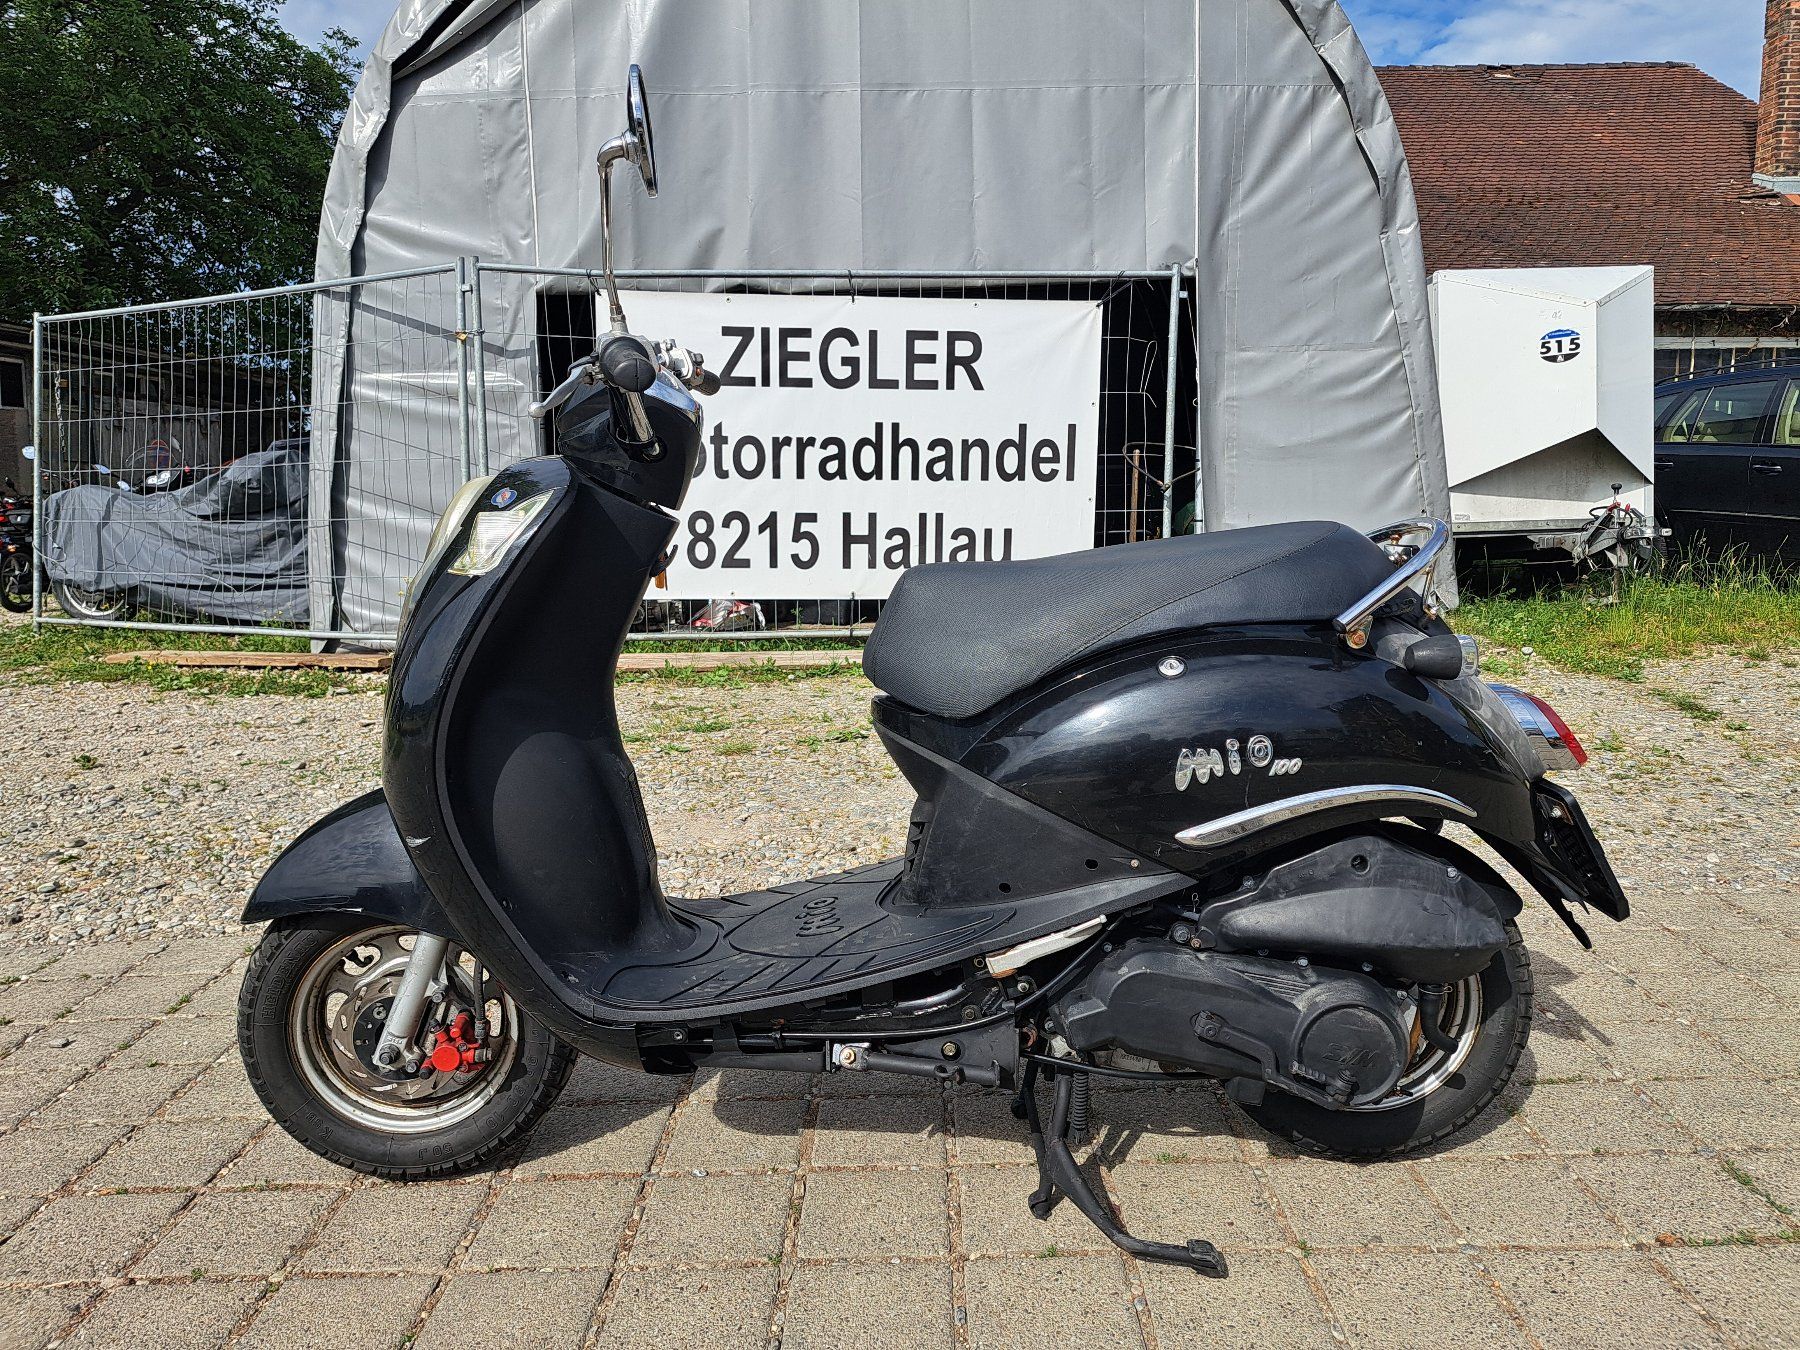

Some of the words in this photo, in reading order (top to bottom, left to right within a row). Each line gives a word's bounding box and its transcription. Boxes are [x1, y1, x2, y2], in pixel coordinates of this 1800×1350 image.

[721, 326, 985, 391] ZIEGLER
[1540, 337, 1581, 355] 515
[686, 510, 821, 570] 8215
[842, 511, 1013, 570] Hallau
